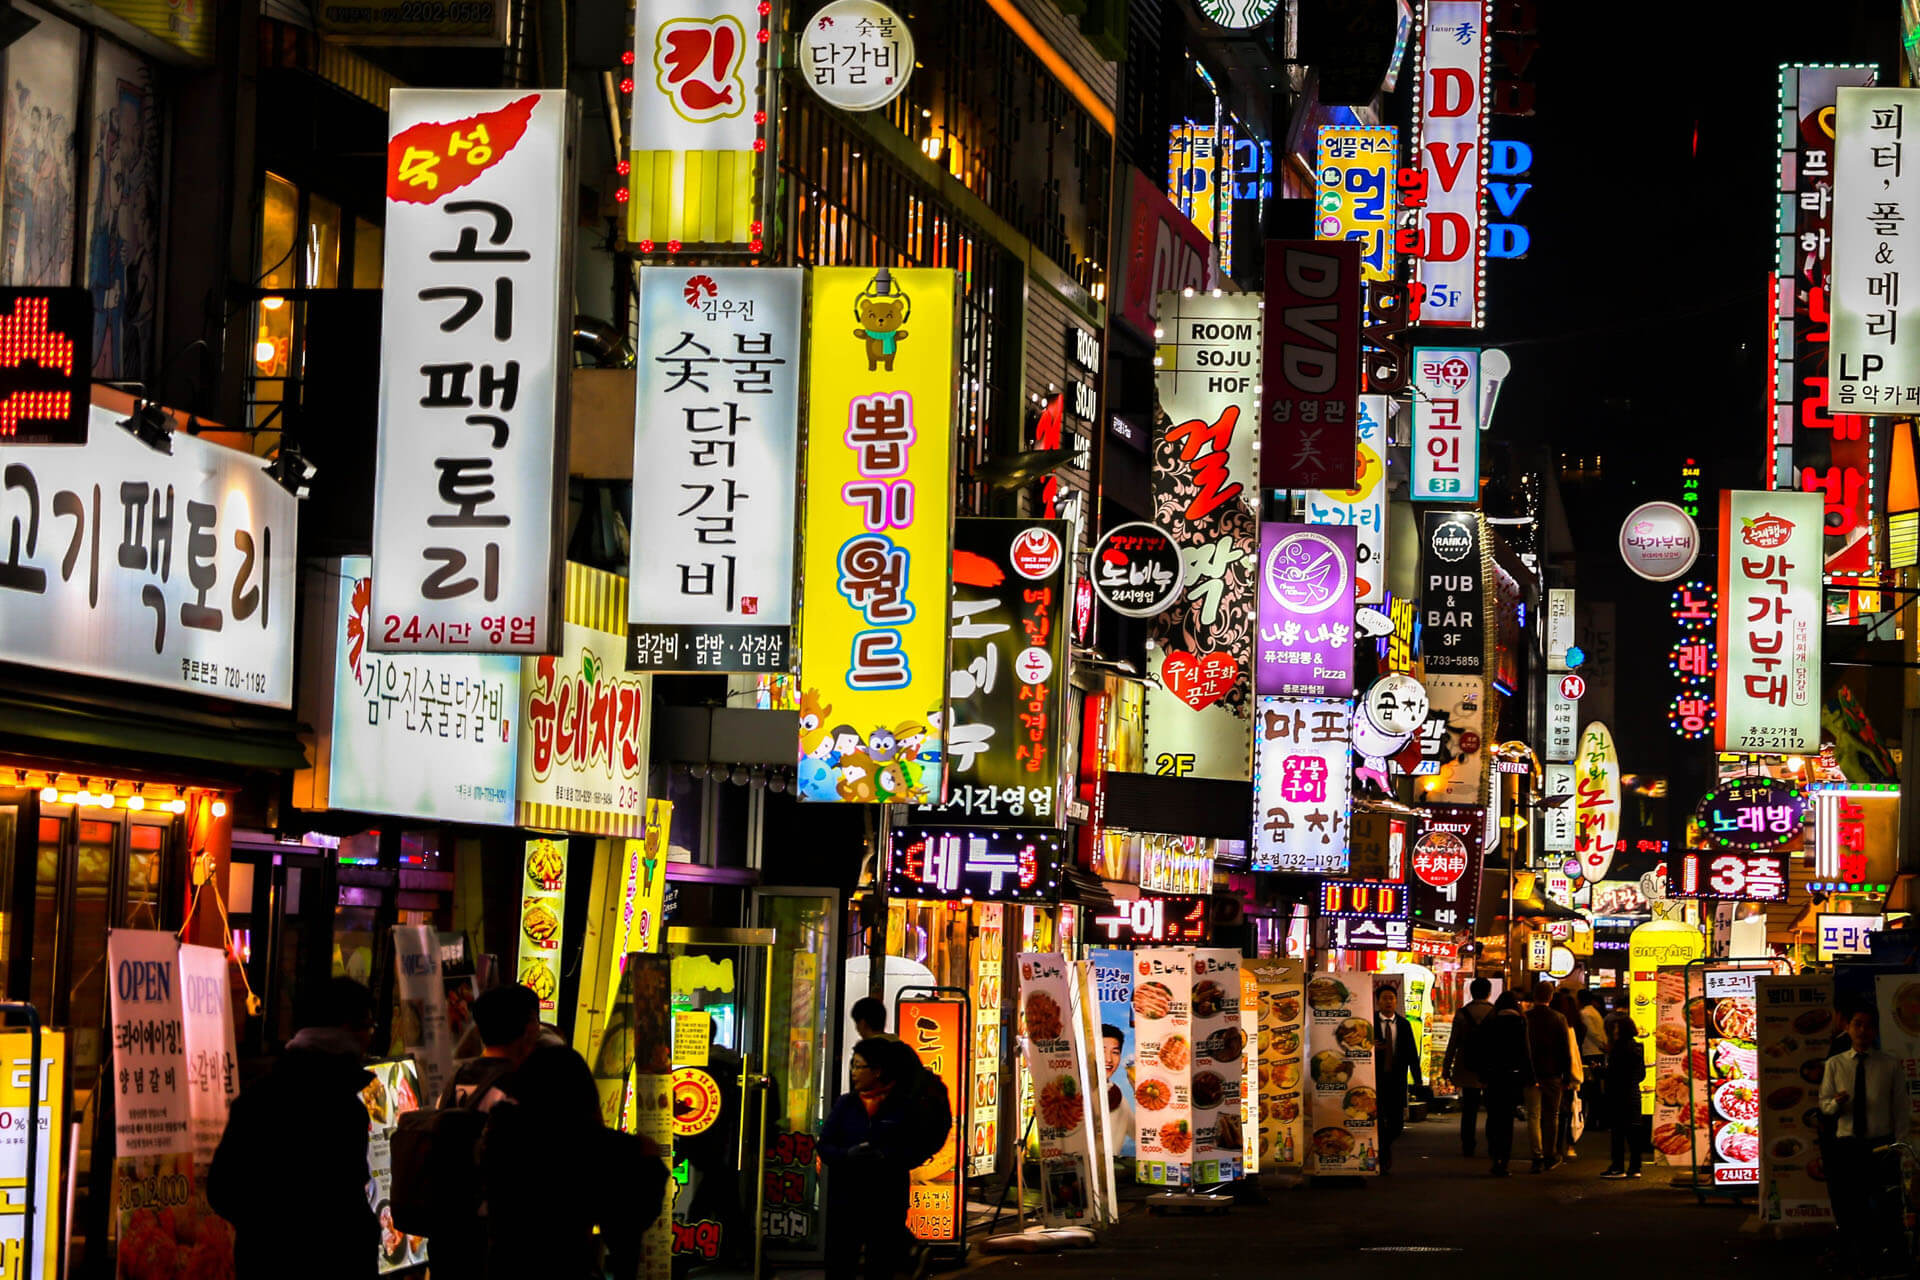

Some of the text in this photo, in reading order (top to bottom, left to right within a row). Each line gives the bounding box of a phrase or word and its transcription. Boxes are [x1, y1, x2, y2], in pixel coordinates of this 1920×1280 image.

[855, 18, 897, 38] 숯불
[1454, 22, 1477, 46] 秀
[811, 42, 899, 86] 닭갈비
[1325, 136, 1391, 158] 엠플러스
[1425, 68, 1475, 262] DVD
[1486, 140, 1533, 259] DVD
[1866, 202, 1906, 236] 폴
[1875, 242, 1894, 264] &
[1429, 284, 1462, 307] 5F
[1865, 272, 1899, 345] 메리
[701, 299, 754, 322] 김우진
[1283, 248, 1340, 394] DVD
[1192, 324, 1252, 340] ROOM
[655, 331, 786, 394] 숯불
[1076, 329, 1100, 374] ROOM
[1196, 351, 1251, 366] SOJU
[1840, 354, 1883, 382] LP
[1208, 377, 1250, 393] HOF
[418, 200, 531, 602] 고기팩토리
[1075, 381, 1097, 423] SOJU
[1271, 399, 1347, 424] 상영관
[1429, 398, 1462, 472] 코인
[1288, 427, 1327, 473] 美
[1433, 479, 1456, 492] 3F
[676, 402, 751, 612] 닭갈비
[842, 394, 911, 683] 뽑기월드
[1435, 538, 1468, 546] RANKA
[1626, 535, 1691, 550] 박가부대
[0, 463, 271, 655] 고기팩토리
[1112, 590, 1154, 603] 24시영업
[1430, 575, 1473, 592] PUB
[1447, 596, 1456, 607] &
[384, 615, 537, 644] 24시간 영업
[1427, 611, 1473, 628] BAR
[1741, 555, 1795, 707] 박가부대
[637, 632, 782, 666] 닭갈비 닭발 삼겹살
[1443, 634, 1462, 646] 3F
[1313, 653, 1323, 664] &
[1425, 655, 1480, 667] T.733-5858
[1678, 590, 1711, 731] 노래방
[182, 657, 266, 694] 종로본점 720-1192
[1167, 659, 1236, 691] 주식 문화
[1313, 667, 1346, 680] Pizza
[364, 659, 504, 743] 김우진숯불닭갈비
[1185, 679, 1221, 705] 공간
[530, 656, 642, 773] 굽네치킨
[1264, 709, 1350, 743] 마포
[1740, 736, 1805, 748] 723-2112
[1749, 726, 1799, 736] 종로2가점
[1157, 754, 1195, 777] 2F
[1497, 762, 1528, 775] KIRIN
[1286, 779, 1321, 799] 구이
[1263, 807, 1342, 844] 곱창
[1425, 820, 1472, 835] Luxury
[1576, 778, 1614, 866] 노래방
[1713, 806, 1794, 832] 노래방
[1838, 796, 1869, 884] 노래방
[1259, 853, 1341, 868] 본점 732-1197
[1415, 856, 1465, 873] 羊肉串
[1711, 856, 1783, 898] 3층
[1326, 886, 1394, 913] DVD
[1095, 900, 1165, 940] 구이
[118, 960, 171, 1000] OPEN
[187, 974, 223, 1015] OPEN
[119, 1066, 176, 1094] 양념갈비
